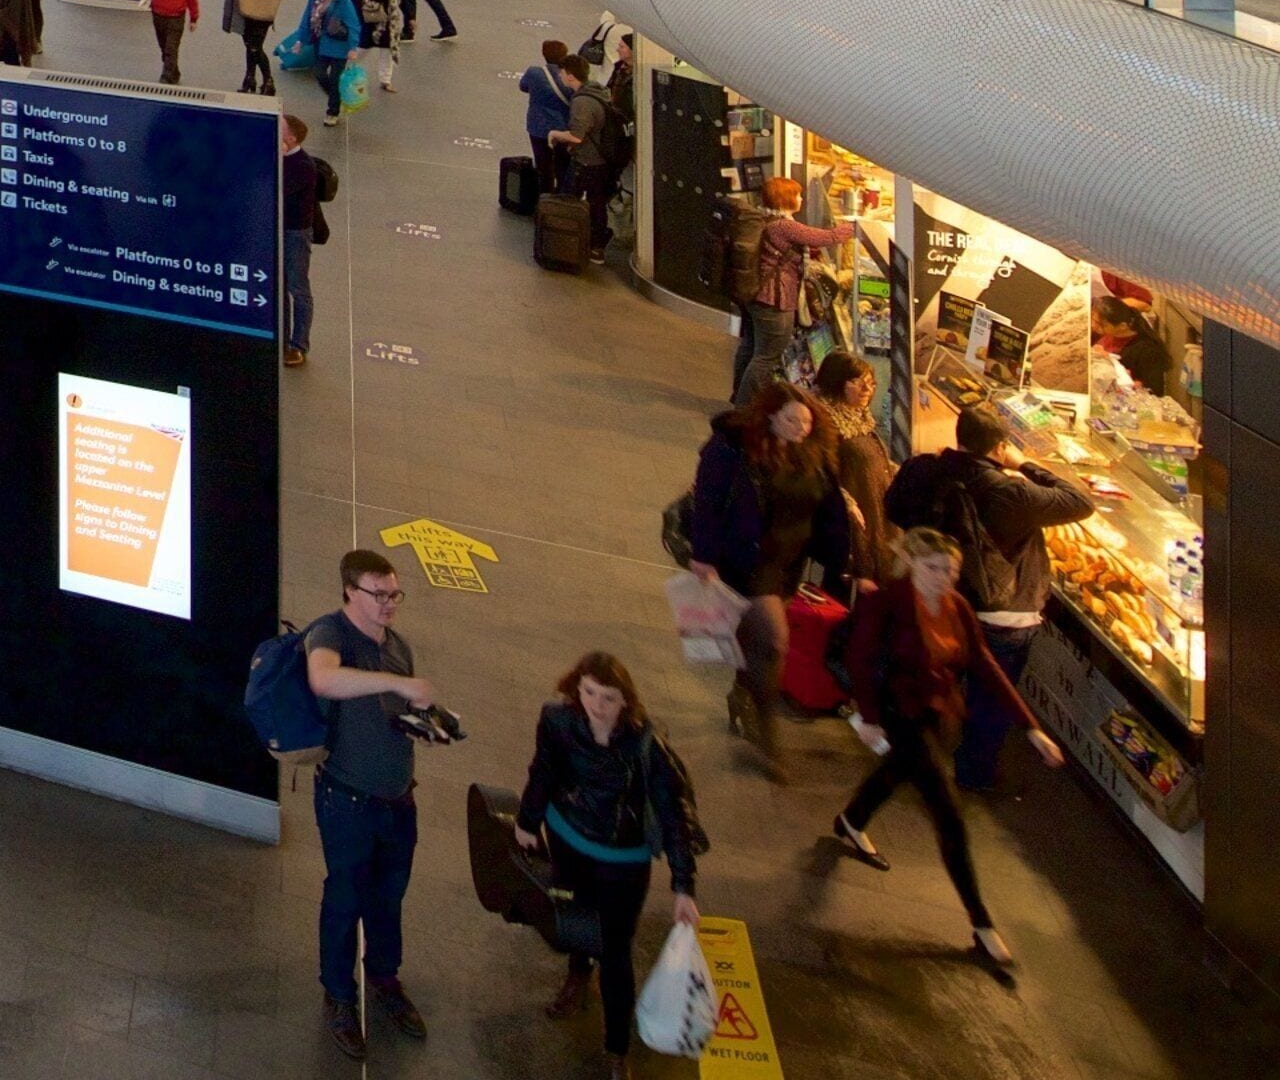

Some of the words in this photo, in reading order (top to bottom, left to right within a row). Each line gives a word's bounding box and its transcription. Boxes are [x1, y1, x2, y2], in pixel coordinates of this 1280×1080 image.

[23, 104, 108, 126] Underground
[23, 128, 85, 148] Platforms
[88, 137, 96, 148] 0
[100, 139, 115, 151] to
[118, 141, 127, 153] 8
[23, 150, 54, 166] Taxis
[23, 173, 65, 193] Dining
[68, 181, 78, 192] &
[81, 183, 129, 203] seating
[23, 196, 68, 215] Tickets
[927, 231, 954, 247] THE
[79, 245, 110, 256] escalator
[116, 247, 180, 269] Platforms
[184, 259, 192, 270] 0
[196, 261, 211, 273] to
[214, 263, 224, 276] 8
[113, 270, 156, 290] Dining
[159, 279, 170, 291] &
[173, 282, 223, 302] seating
[74, 422, 133, 443] Additional
[75, 437, 116, 453] seating
[75, 447, 116, 465] located
[118, 457, 132, 468] on
[134, 460, 155, 473] the
[75, 463, 107, 476] upper
[74, 474, 134, 495] Mezzanine
[135, 488, 166, 501] Level
[75, 499, 110, 515] Please
[112, 506, 148, 522] follow
[74, 513, 102, 526] signs
[104, 519, 117, 529] to
[120, 522, 157, 540] Dining
[409, 525, 452, 538] Lifts
[75, 526, 96, 538] and
[99, 529, 141, 550] Seating
[438, 539, 474, 550] way
[1025, 673, 1122, 798] ORNWALL
[713, 980, 751, 989] UTION
[709, 1047, 733, 1059] WET
[735, 1050, 770, 1063] FLOOR
